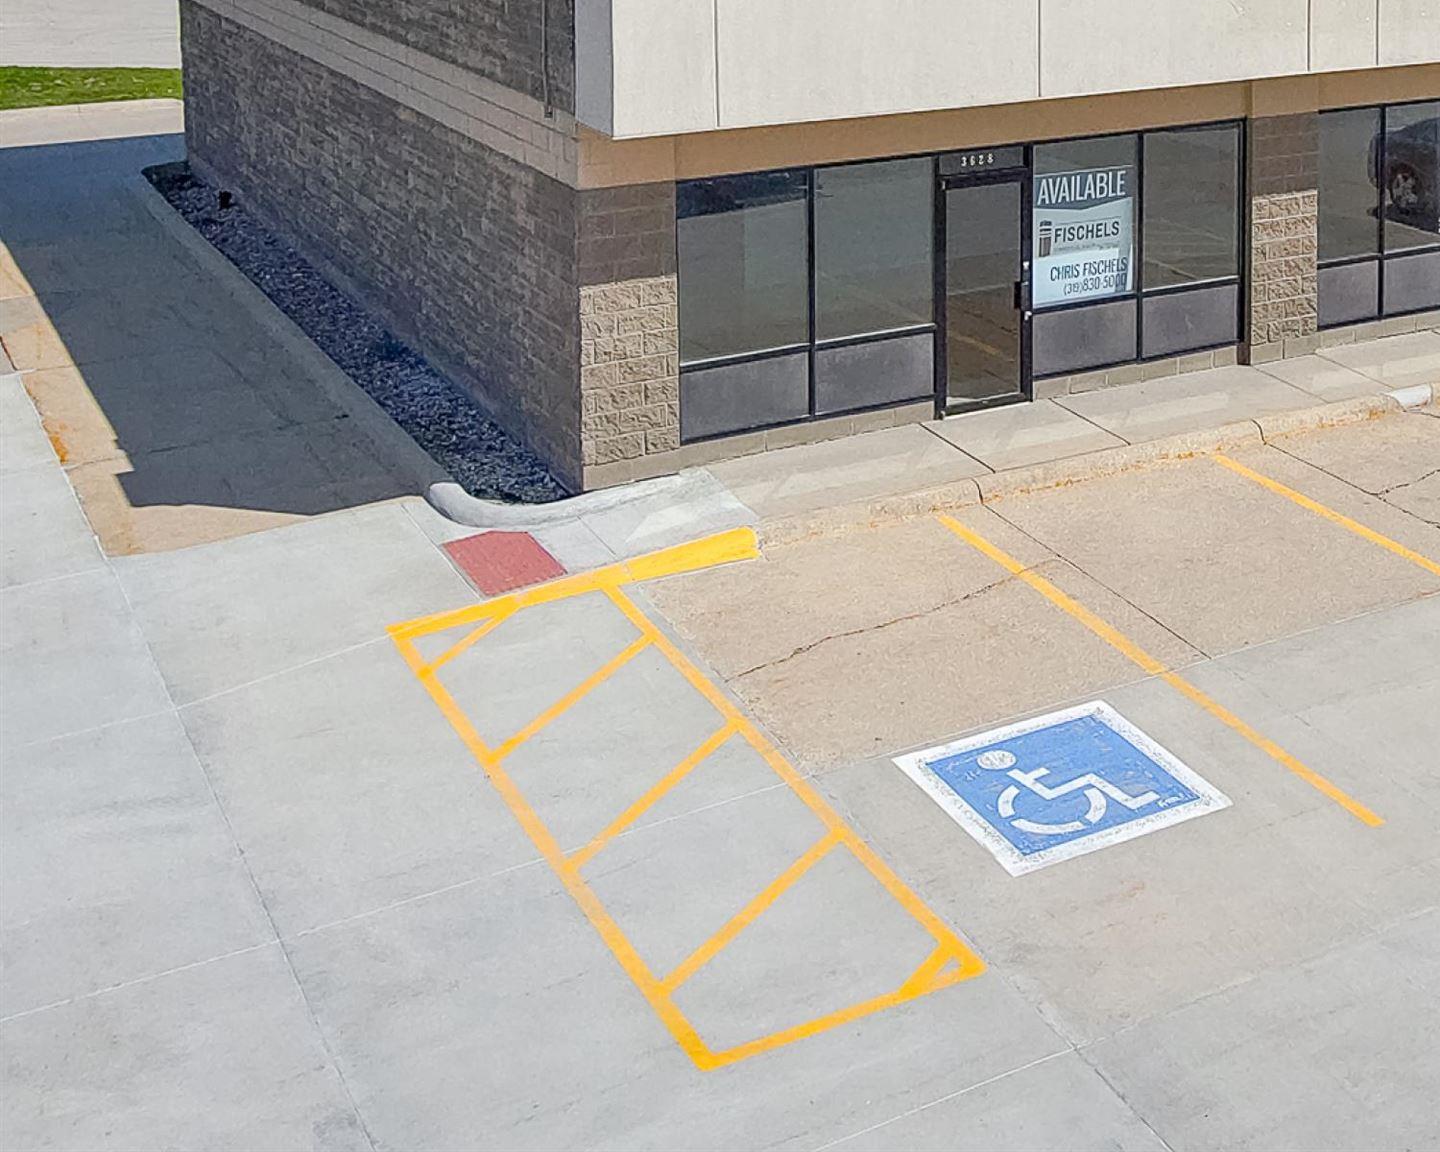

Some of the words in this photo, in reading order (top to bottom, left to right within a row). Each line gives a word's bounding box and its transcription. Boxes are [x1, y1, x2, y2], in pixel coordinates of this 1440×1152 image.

[1037, 170, 1127, 205] AVAILABLE
[1054, 221, 1120, 243] FISCHELS
[1050, 263, 1081, 281] CHRIS
[1083, 256, 1129, 276] FISCHELS
